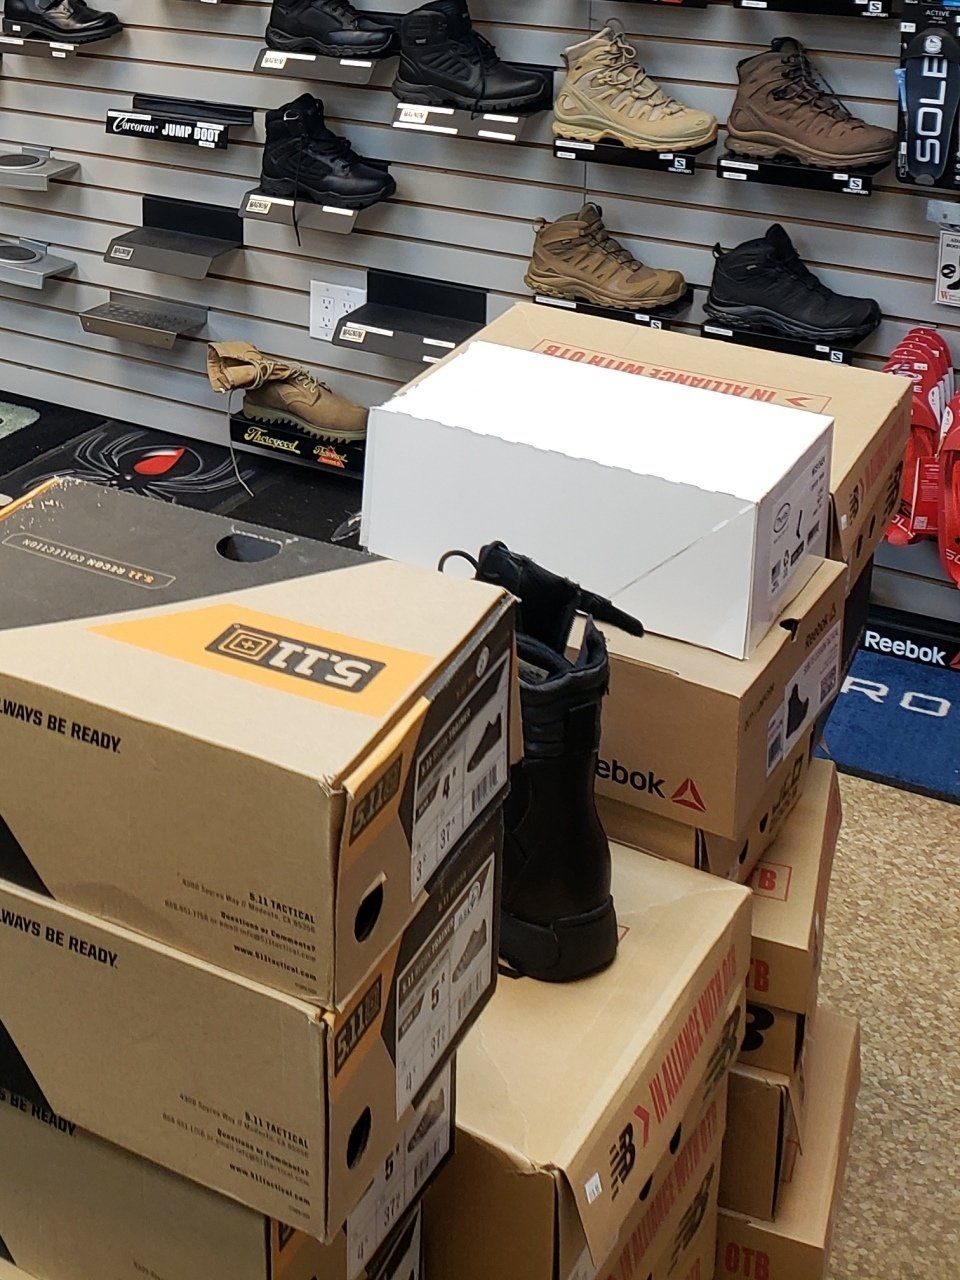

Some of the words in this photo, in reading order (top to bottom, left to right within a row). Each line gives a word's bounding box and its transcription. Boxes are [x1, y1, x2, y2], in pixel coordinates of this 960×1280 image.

[925, 9, 951, 17] ACTIVE
[916, 57, 947, 166] SOLE
[112, 115, 155, 134] Corcoran
[161, 123, 192, 139] JUMP
[193, 127, 220, 143] BOOT
[245, 425, 301, 454] Thorogood
[273, 638, 375, 689] 5.11
[865, 631, 946, 667] Reebok
[47, 715, 67, 735] BE
[70, 721, 122, 754] READY.
[594, 758, 666, 799] ebok
[249, 891, 269, 907] 5.11
[271, 901, 316, 924] TACTICAL
[45, 925, 65, 947] BE
[68, 935, 119, 969] READY.
[220, 911, 259, 931] Questions
[271, 929, 316, 952] Comments?
[9, 1090, 27, 1113] BE
[217, 1128, 254, 1151] Questions
[266, 1121, 309, 1149] TACTICAL
